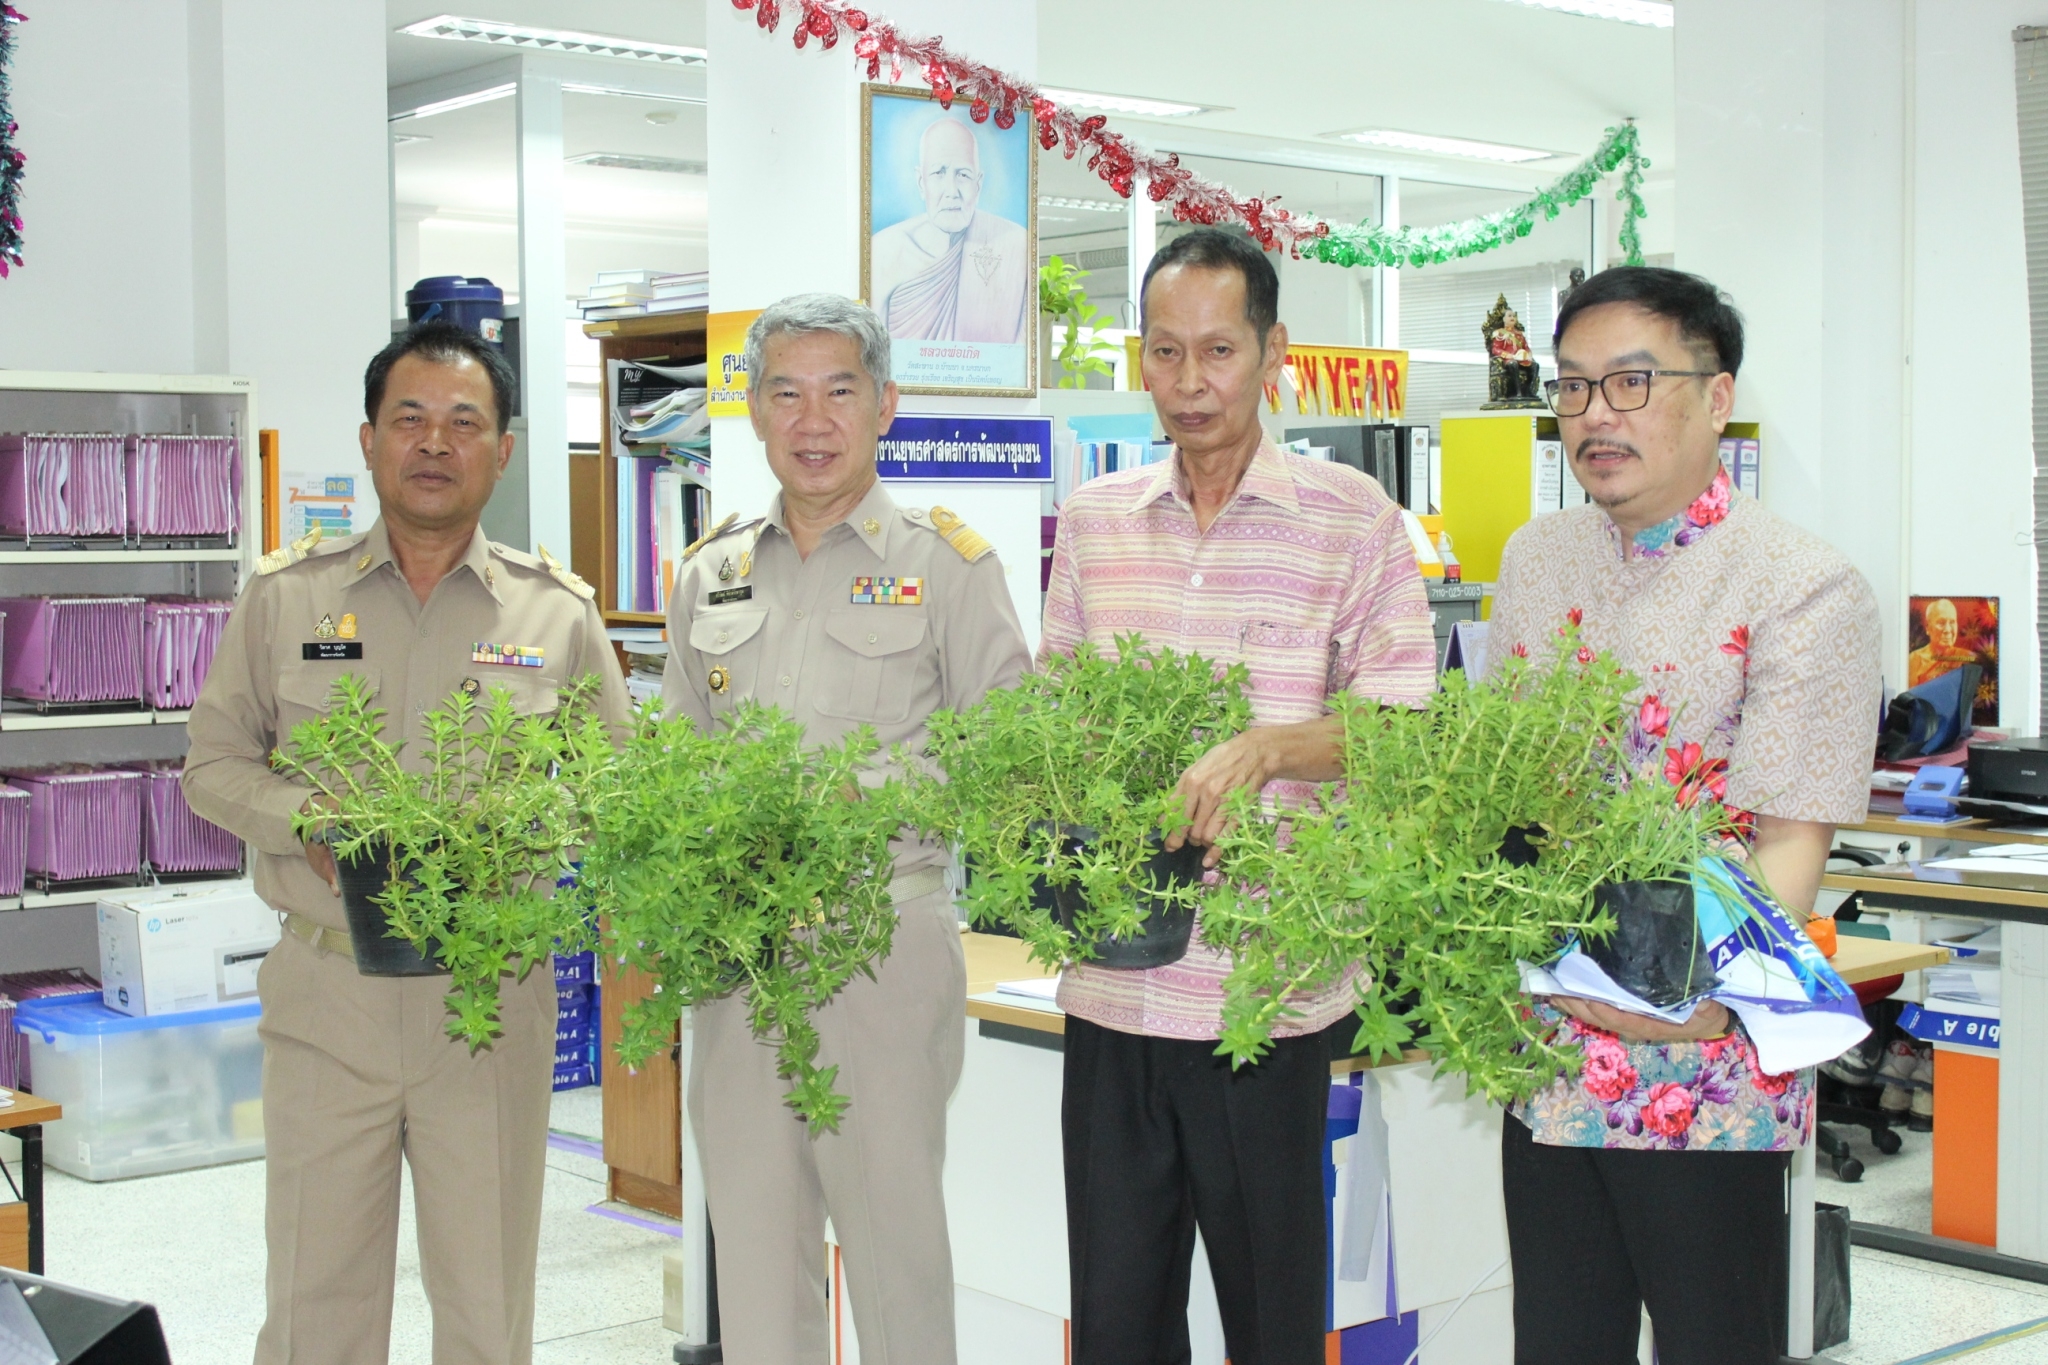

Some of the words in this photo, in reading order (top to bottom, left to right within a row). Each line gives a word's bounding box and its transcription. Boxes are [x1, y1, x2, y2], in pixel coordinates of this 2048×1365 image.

[919, 345, 981, 359] หลวงพ่อเกิด
[1322, 355, 1401, 411] YEAR
[710, 387, 747, 402] สำนักงาน
[875, 430, 1041, 474] งานยุทธศาสตร์การพัฒนาชุมชน
[165, 916, 185, 925] Laser
[552, 1074, 569, 1085] ble
